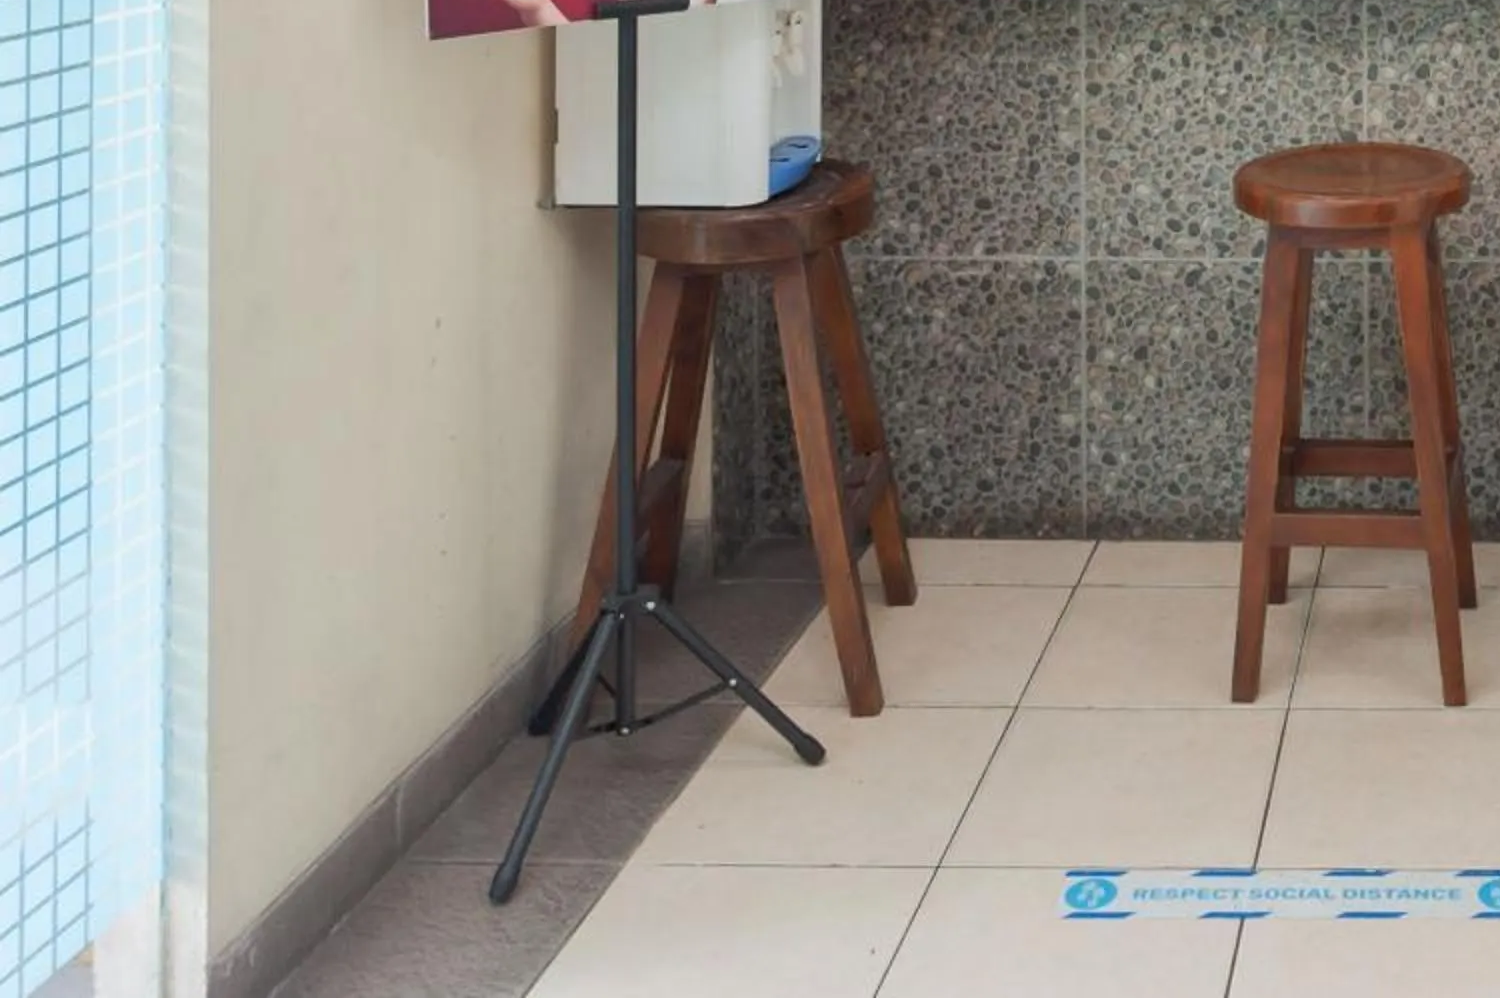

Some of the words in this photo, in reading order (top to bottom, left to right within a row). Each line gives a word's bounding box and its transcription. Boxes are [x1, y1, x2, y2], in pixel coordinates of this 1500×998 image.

[1132, 887, 1242, 901] RESPECT
[1248, 886, 1337, 900] SOCIAL
[1342, 886, 1465, 901] DISTANCE
